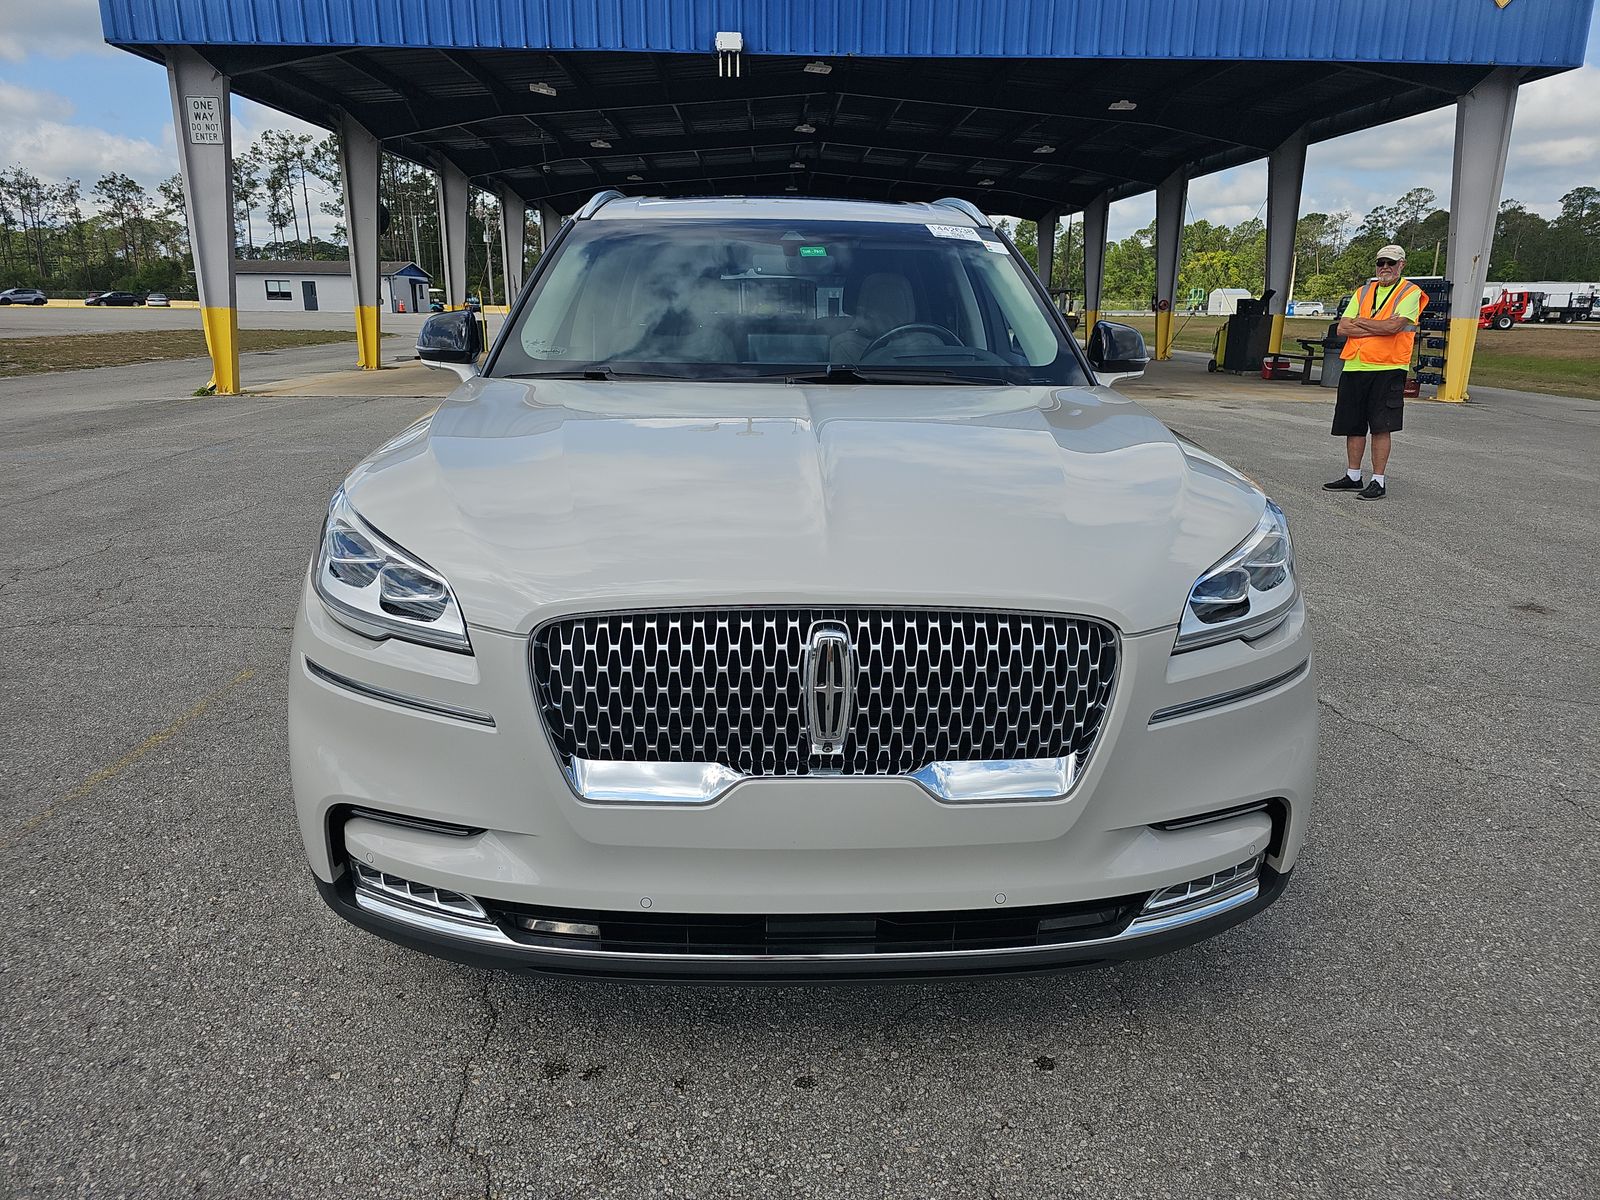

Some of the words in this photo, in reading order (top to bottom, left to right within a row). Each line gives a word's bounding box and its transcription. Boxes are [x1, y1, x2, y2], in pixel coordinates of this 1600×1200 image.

[193, 100, 213, 110] ONE
[193, 111, 214, 121] WAY
[192, 123, 201, 131] DO
[205, 123, 219, 131] NOT
[195, 132, 218, 141] ENTER
